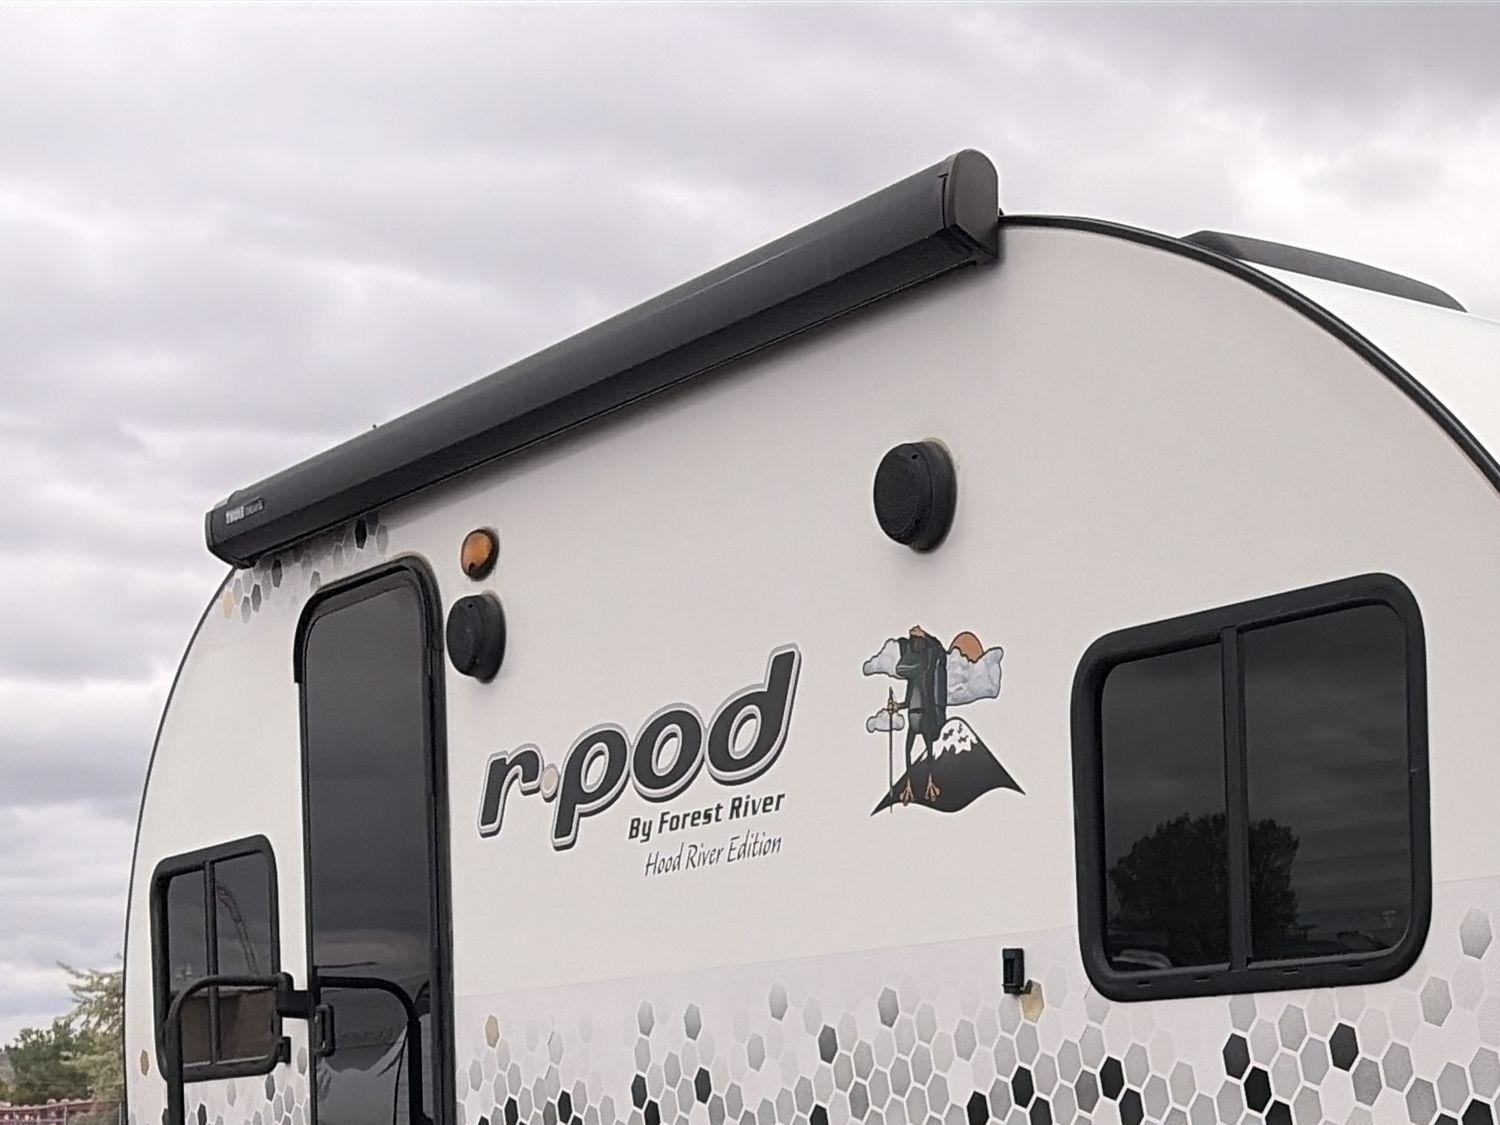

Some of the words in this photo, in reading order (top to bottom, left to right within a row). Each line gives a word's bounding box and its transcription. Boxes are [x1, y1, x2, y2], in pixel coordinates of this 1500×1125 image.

[628, 817, 653, 843] By
[657, 803, 724, 834] Forest
[728, 793, 786, 820] River
[644, 841, 685, 877] Hood
[685, 843, 725, 870] River
[727, 829, 782, 863] Edition
